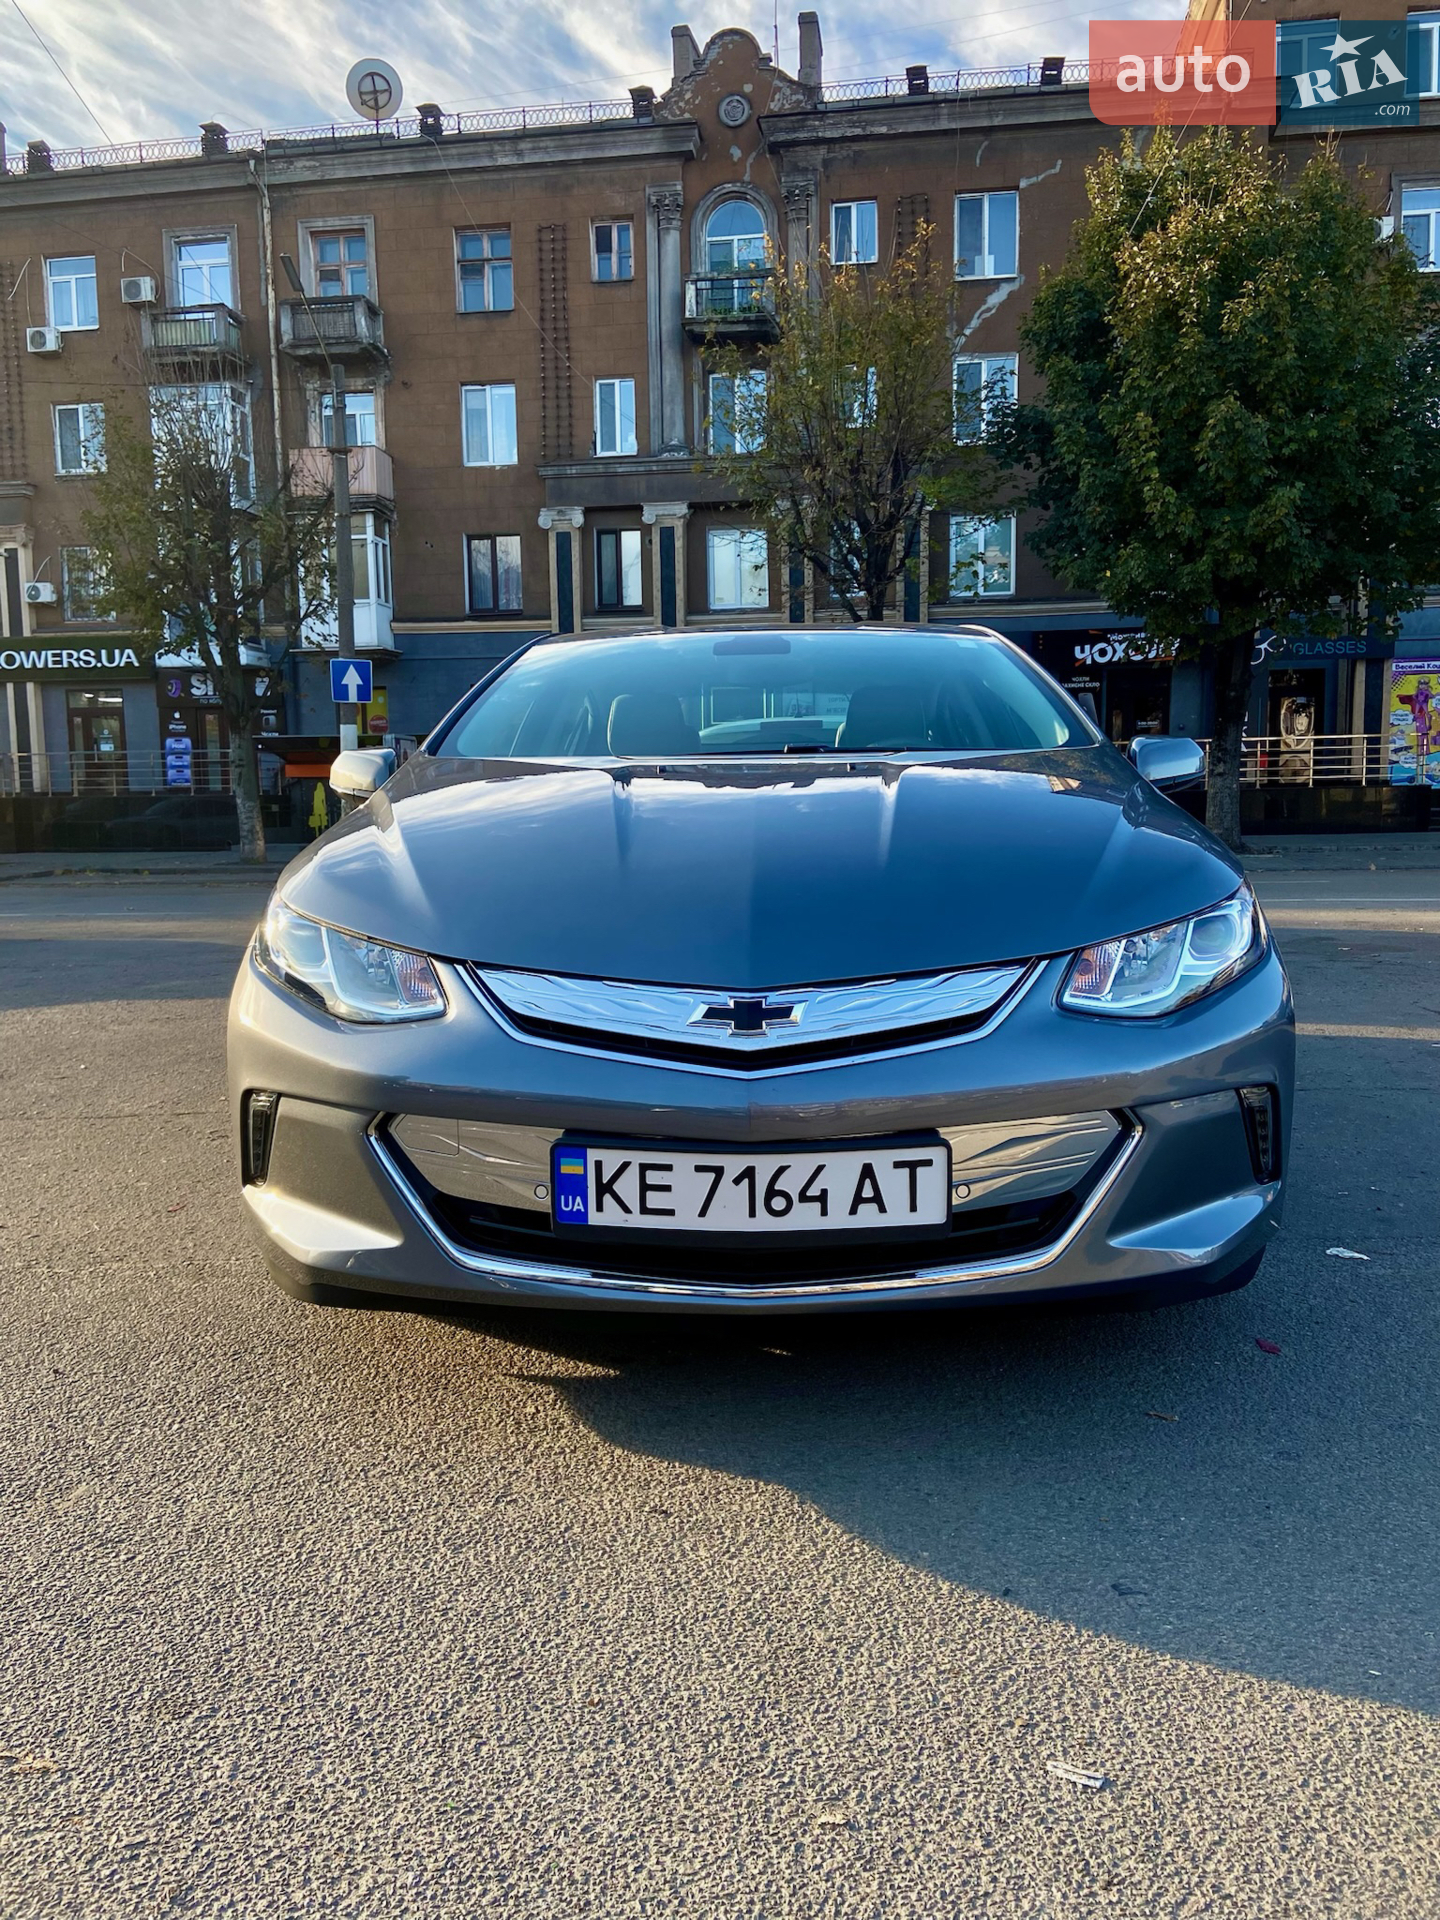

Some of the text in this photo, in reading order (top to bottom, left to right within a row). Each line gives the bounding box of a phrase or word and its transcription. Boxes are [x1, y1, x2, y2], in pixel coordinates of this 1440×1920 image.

[1293, 640, 1367, 655] GLASSES
[0, 648, 140, 669] OWERS.UA
[594, 1157, 935, 1219] KE 7164 AT
[560, 1194, 586, 1213] UA
